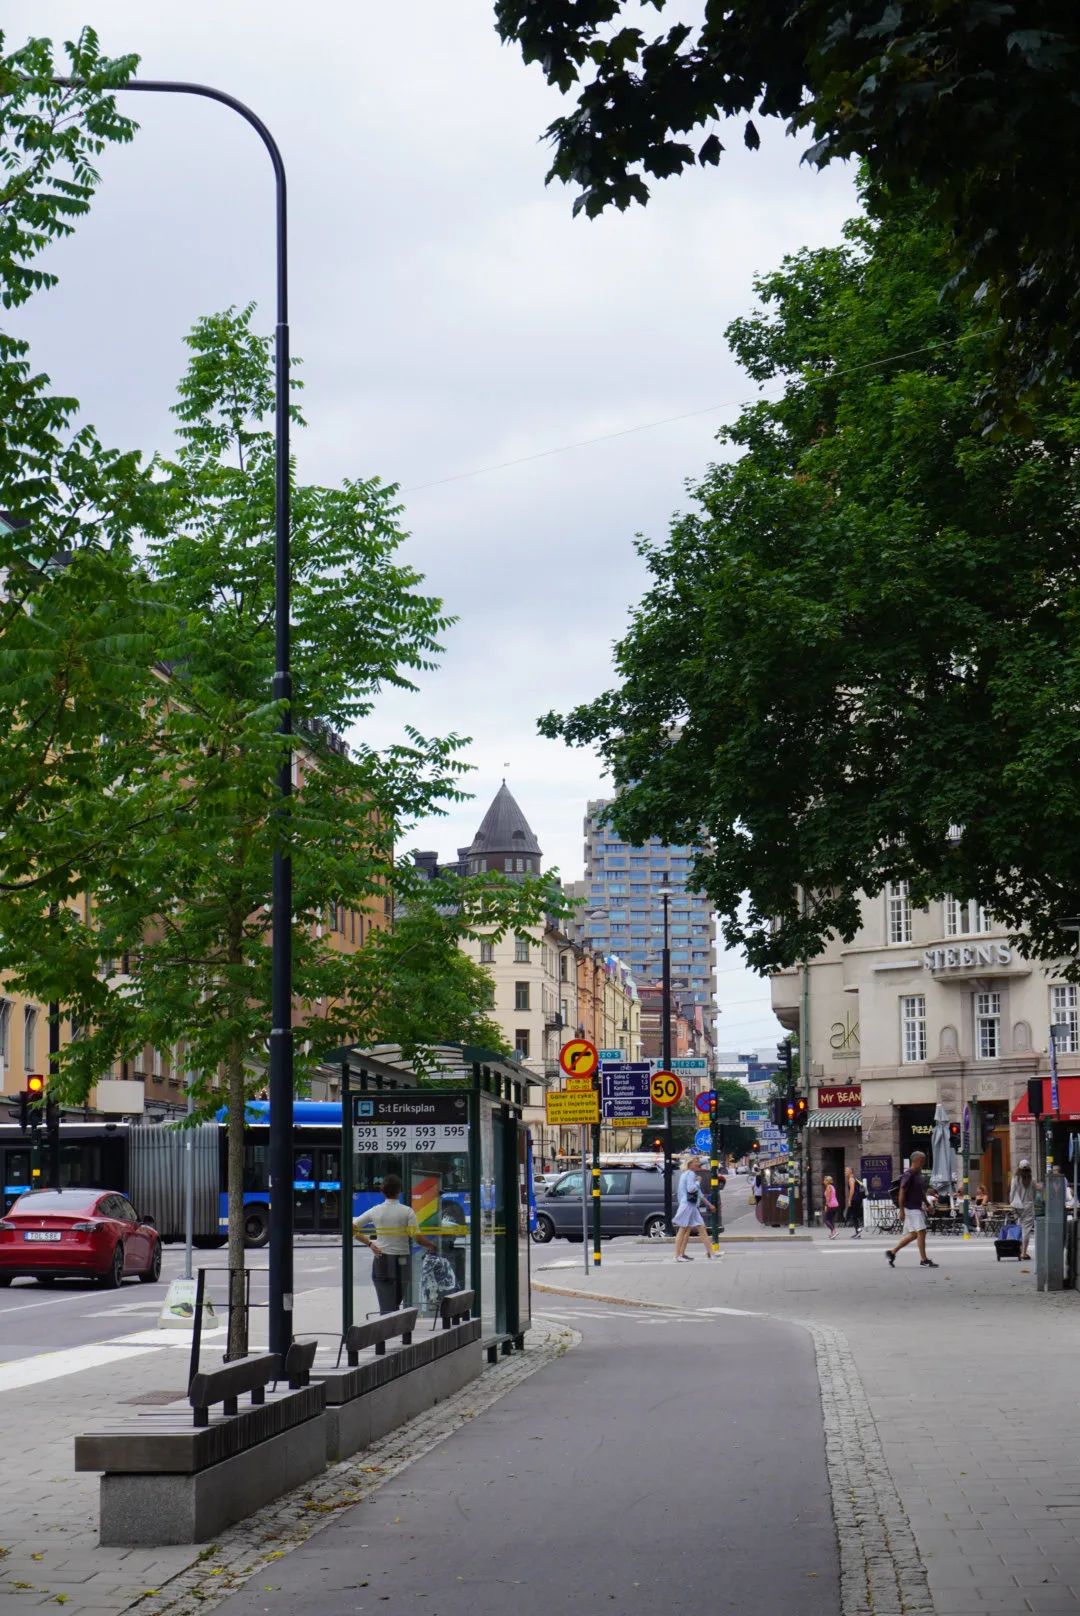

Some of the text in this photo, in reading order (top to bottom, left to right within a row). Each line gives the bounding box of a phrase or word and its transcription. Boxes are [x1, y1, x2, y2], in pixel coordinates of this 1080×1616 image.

[923, 944, 1012, 970] STEENS
[653, 1080, 677, 1097] 50
[821, 1094, 834, 1103] Mr
[379, 1103, 435, 1114] S:t Eriksplan
[358, 1127, 464, 1137] 591 592 593 595
[912, 1126, 933, 1134] PIZZA
[358, 1141, 436, 1151] 598 599 697
